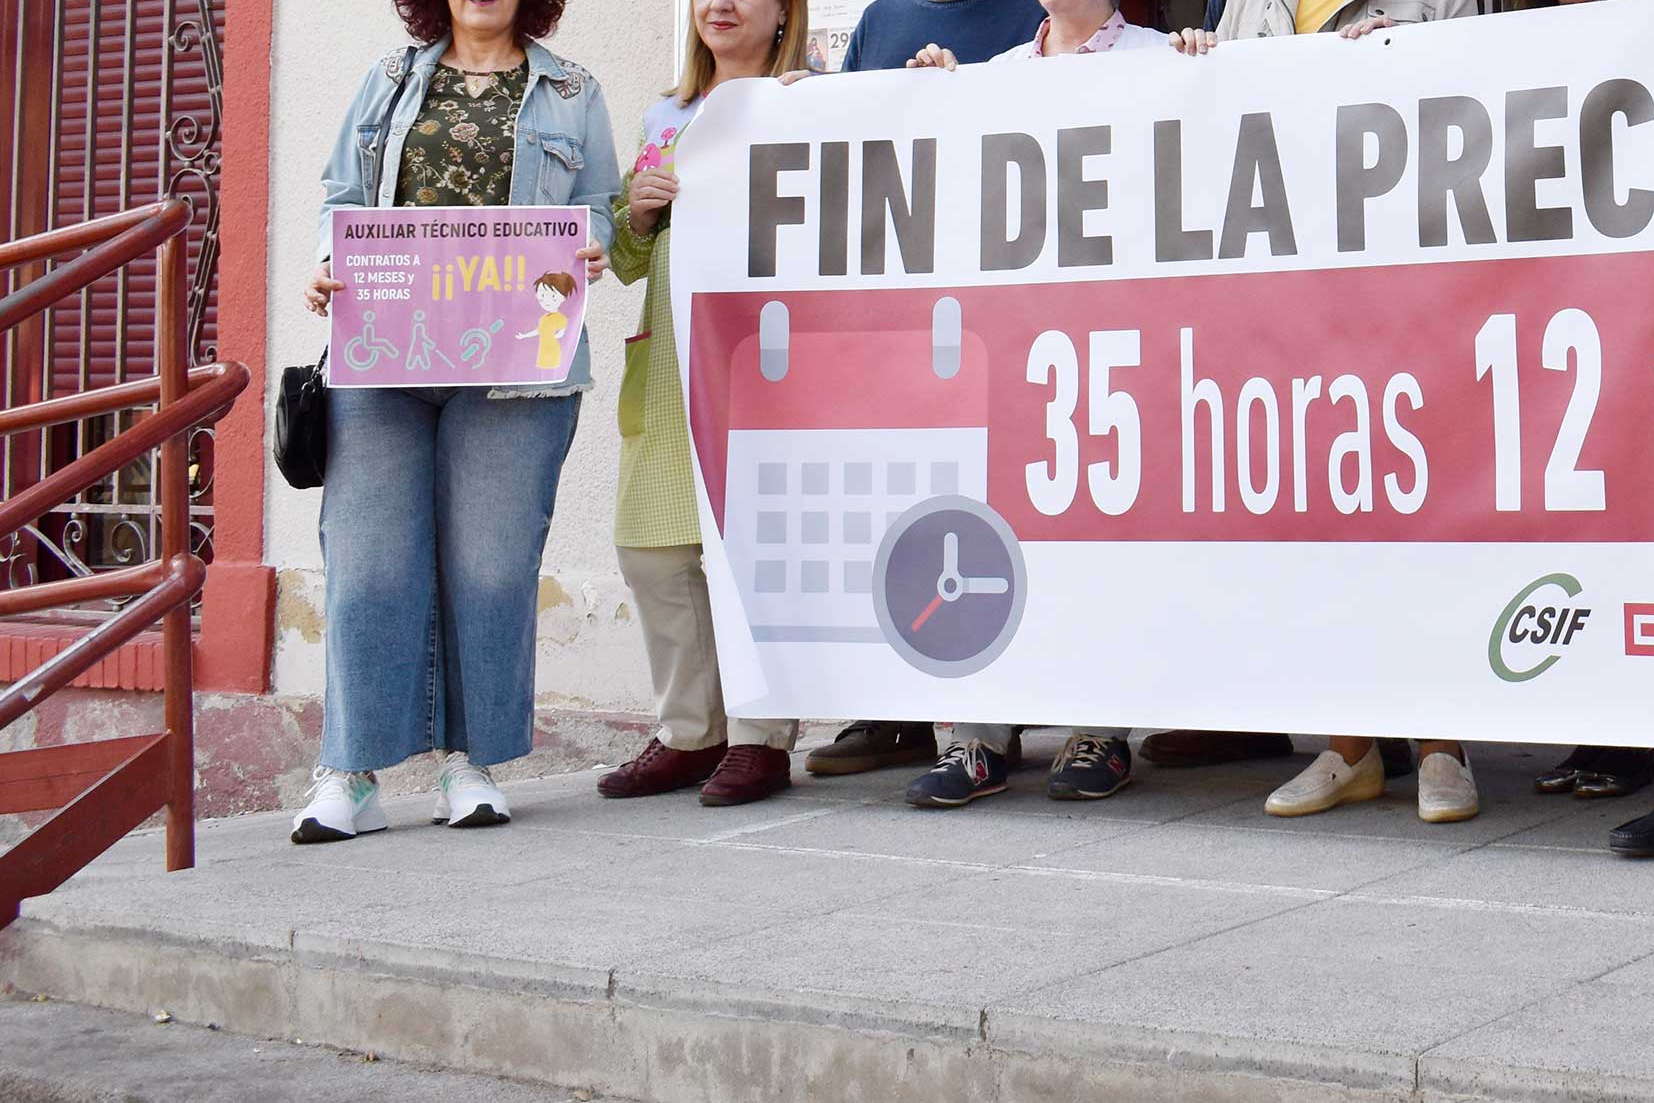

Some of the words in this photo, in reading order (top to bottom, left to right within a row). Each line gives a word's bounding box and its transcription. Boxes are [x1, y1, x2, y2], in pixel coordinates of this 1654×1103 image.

[748, 138, 937, 278] FIN
[980, 124, 1114, 271] DE
[1153, 111, 1298, 263] LA
[345, 223, 416, 239] AUXILIAR
[421, 218, 487, 238] TÉCNICO
[493, 221, 579, 238] EDUCATIVO
[346, 254, 408, 267] CONTRATOS
[410, 254, 421, 266] A
[354, 272, 365, 284] 12
[368, 271, 406, 283] MESES
[408, 274, 415, 285] y
[431, 255, 526, 301] ¡¡YA!!
[357, 289, 370, 300] 35
[373, 288, 410, 300] HORAS
[1025, 328, 1141, 516] 35
[1180, 326, 1430, 516] horas
[1473, 308, 1606, 512] 12
[1508, 605, 1592, 645] CSIF
